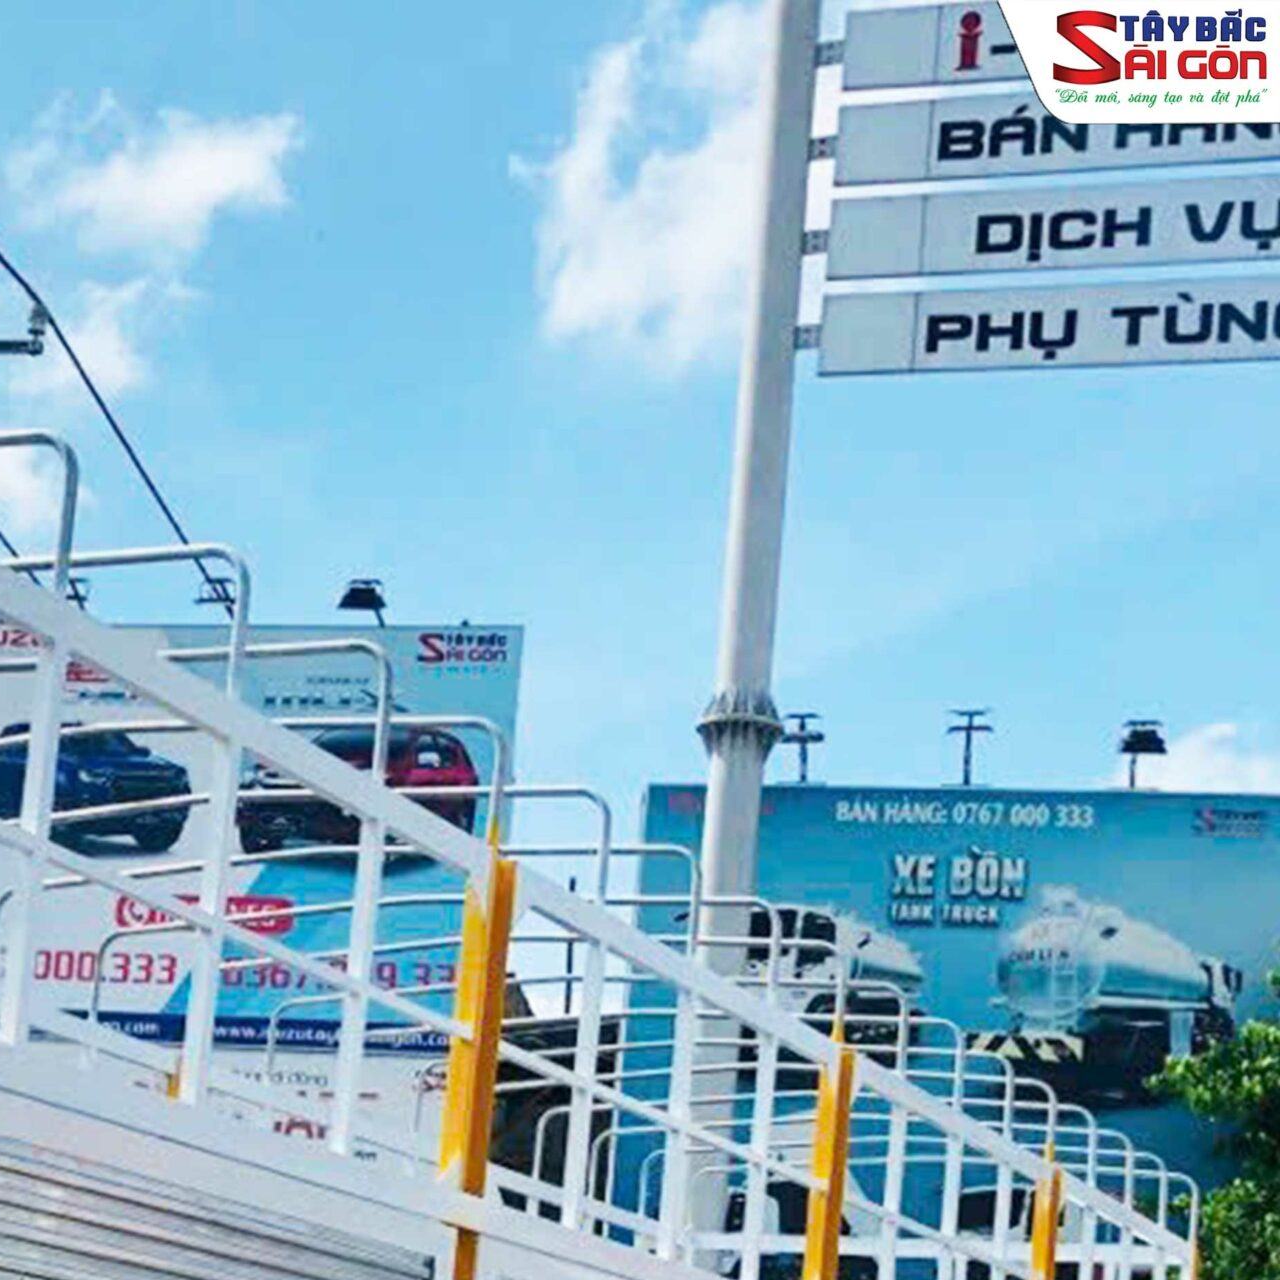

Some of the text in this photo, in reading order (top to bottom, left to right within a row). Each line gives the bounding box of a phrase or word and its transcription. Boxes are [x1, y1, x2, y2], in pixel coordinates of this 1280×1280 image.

[936, 105, 1089, 162] BÁN
[974, 200, 1280, 262] DỊCH VỤ
[925, 292, 1280, 361] PHỤ TÙN
[835, 795, 879, 822] BÁN
[952, 800, 1005, 826] 0767
[1054, 804, 1095, 830] 333
[892, 844, 1026, 900] XE BỒN
